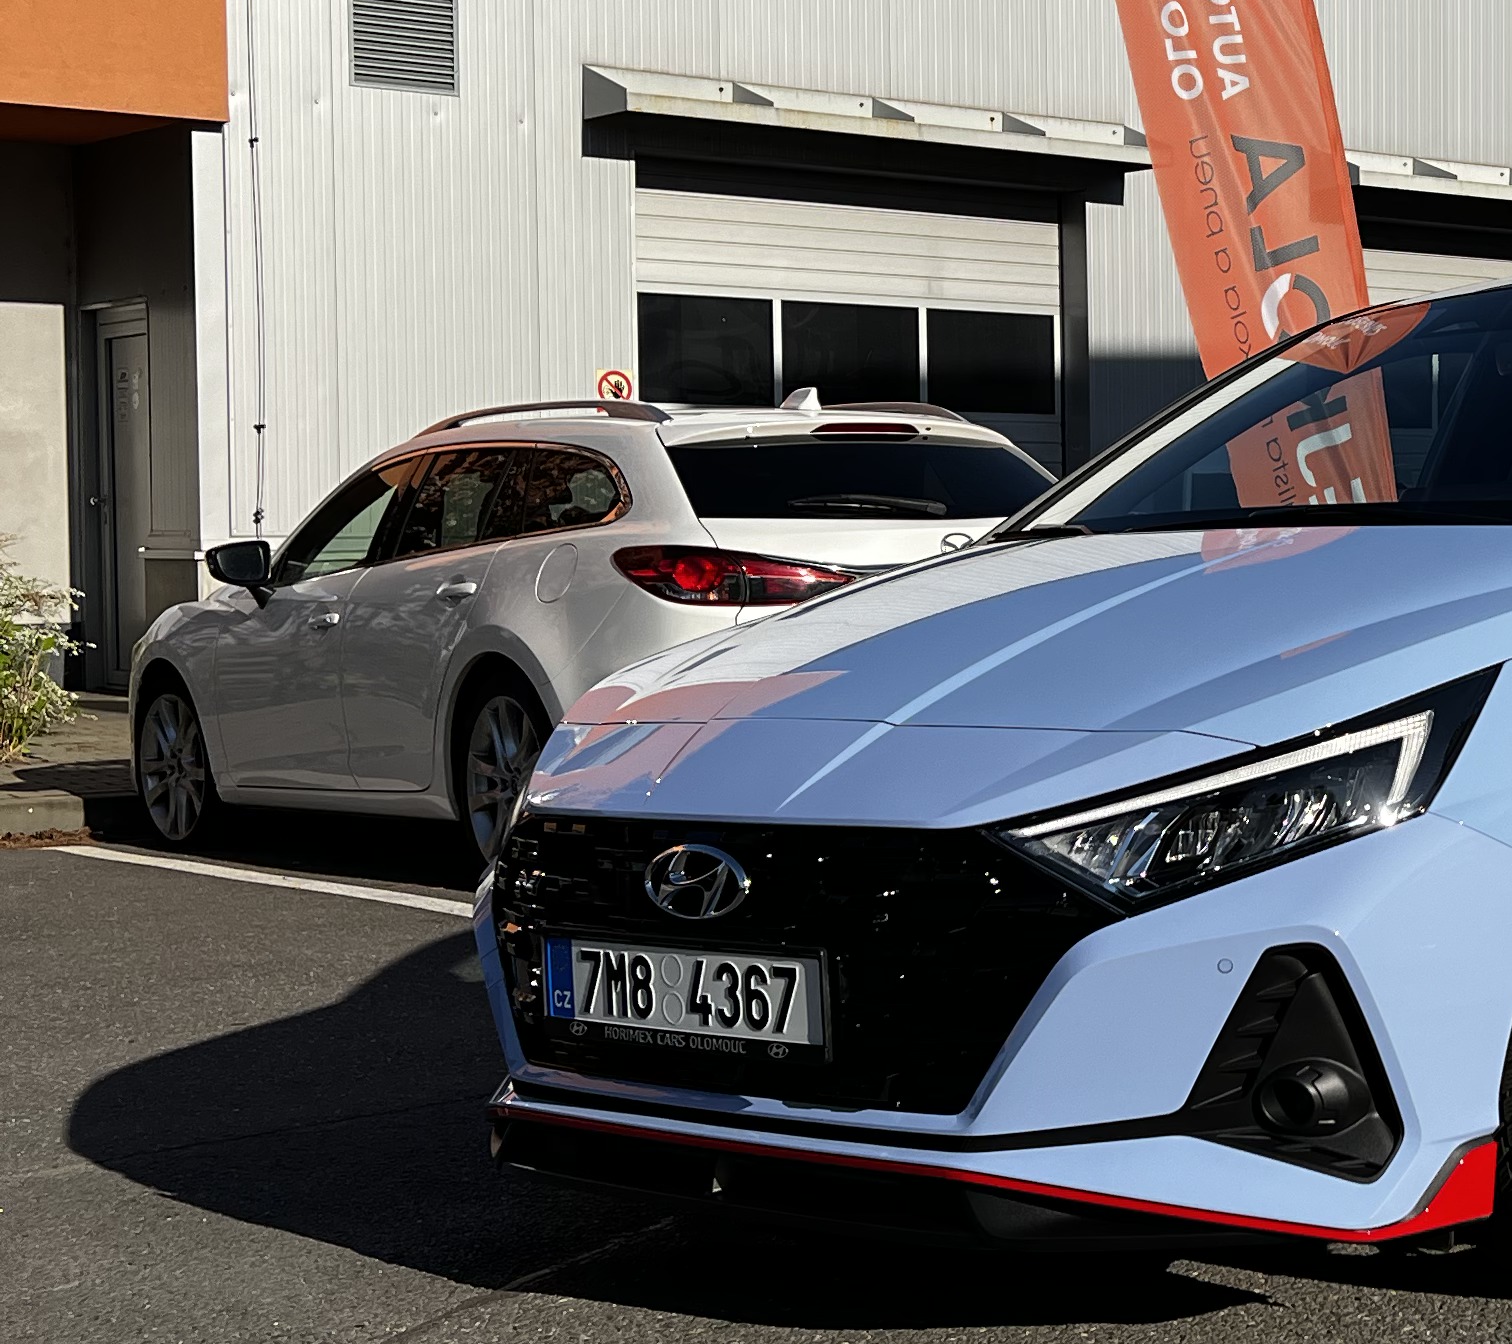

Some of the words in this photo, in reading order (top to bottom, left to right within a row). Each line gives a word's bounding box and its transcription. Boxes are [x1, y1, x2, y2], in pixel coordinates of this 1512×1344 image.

[553, 990, 572, 1009] CZ
[577, 948, 656, 1019] 7M8
[687, 958, 799, 1035] 4367
[604, 1025, 653, 1044] HORIMEX
[657, 1032, 686, 1048] CARS
[689, 1035, 747, 1054] OLOMOUC
